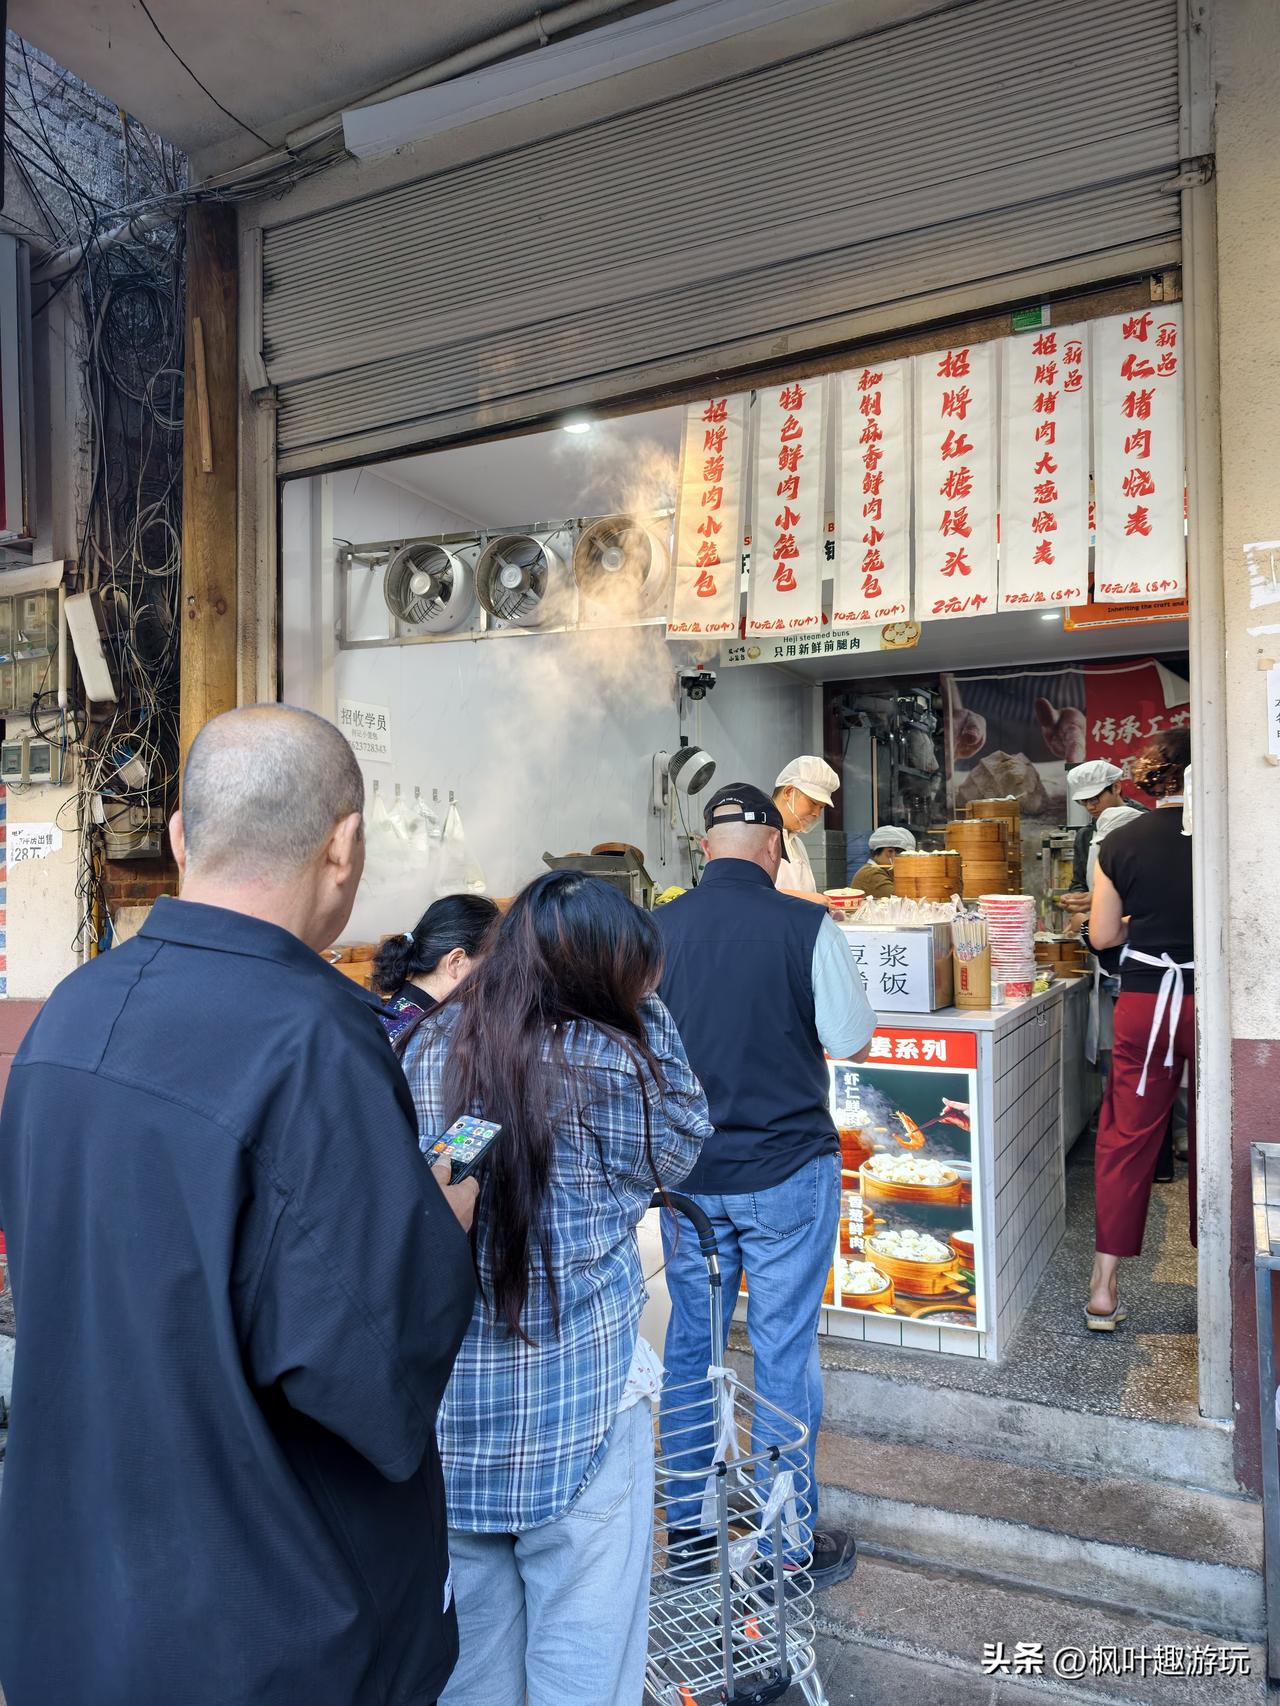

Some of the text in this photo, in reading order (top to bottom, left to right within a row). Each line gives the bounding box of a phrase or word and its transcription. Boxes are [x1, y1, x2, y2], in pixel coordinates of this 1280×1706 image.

[694, 398, 728, 598] 招牌酱肉小笼包
[772, 383, 806, 592] 特色鲜肉小笼包
[857, 369, 885, 598] 秘制麻香鲜肉小笼包
[936, 348, 974, 577] 招牌红糖馒头
[1031, 332, 1060, 566] 招牌猪肉大葱烧麦
[1120, 312, 1156, 537] 虾仁猪肉烧麦
[774, 637, 860, 657] 只用新鲜前腿肉
[800, 631, 831, 641] steamed
[832, 630, 850, 638] buns
[931, 593, 988, 614] 2元/个
[341, 708, 387, 731] 招收学员
